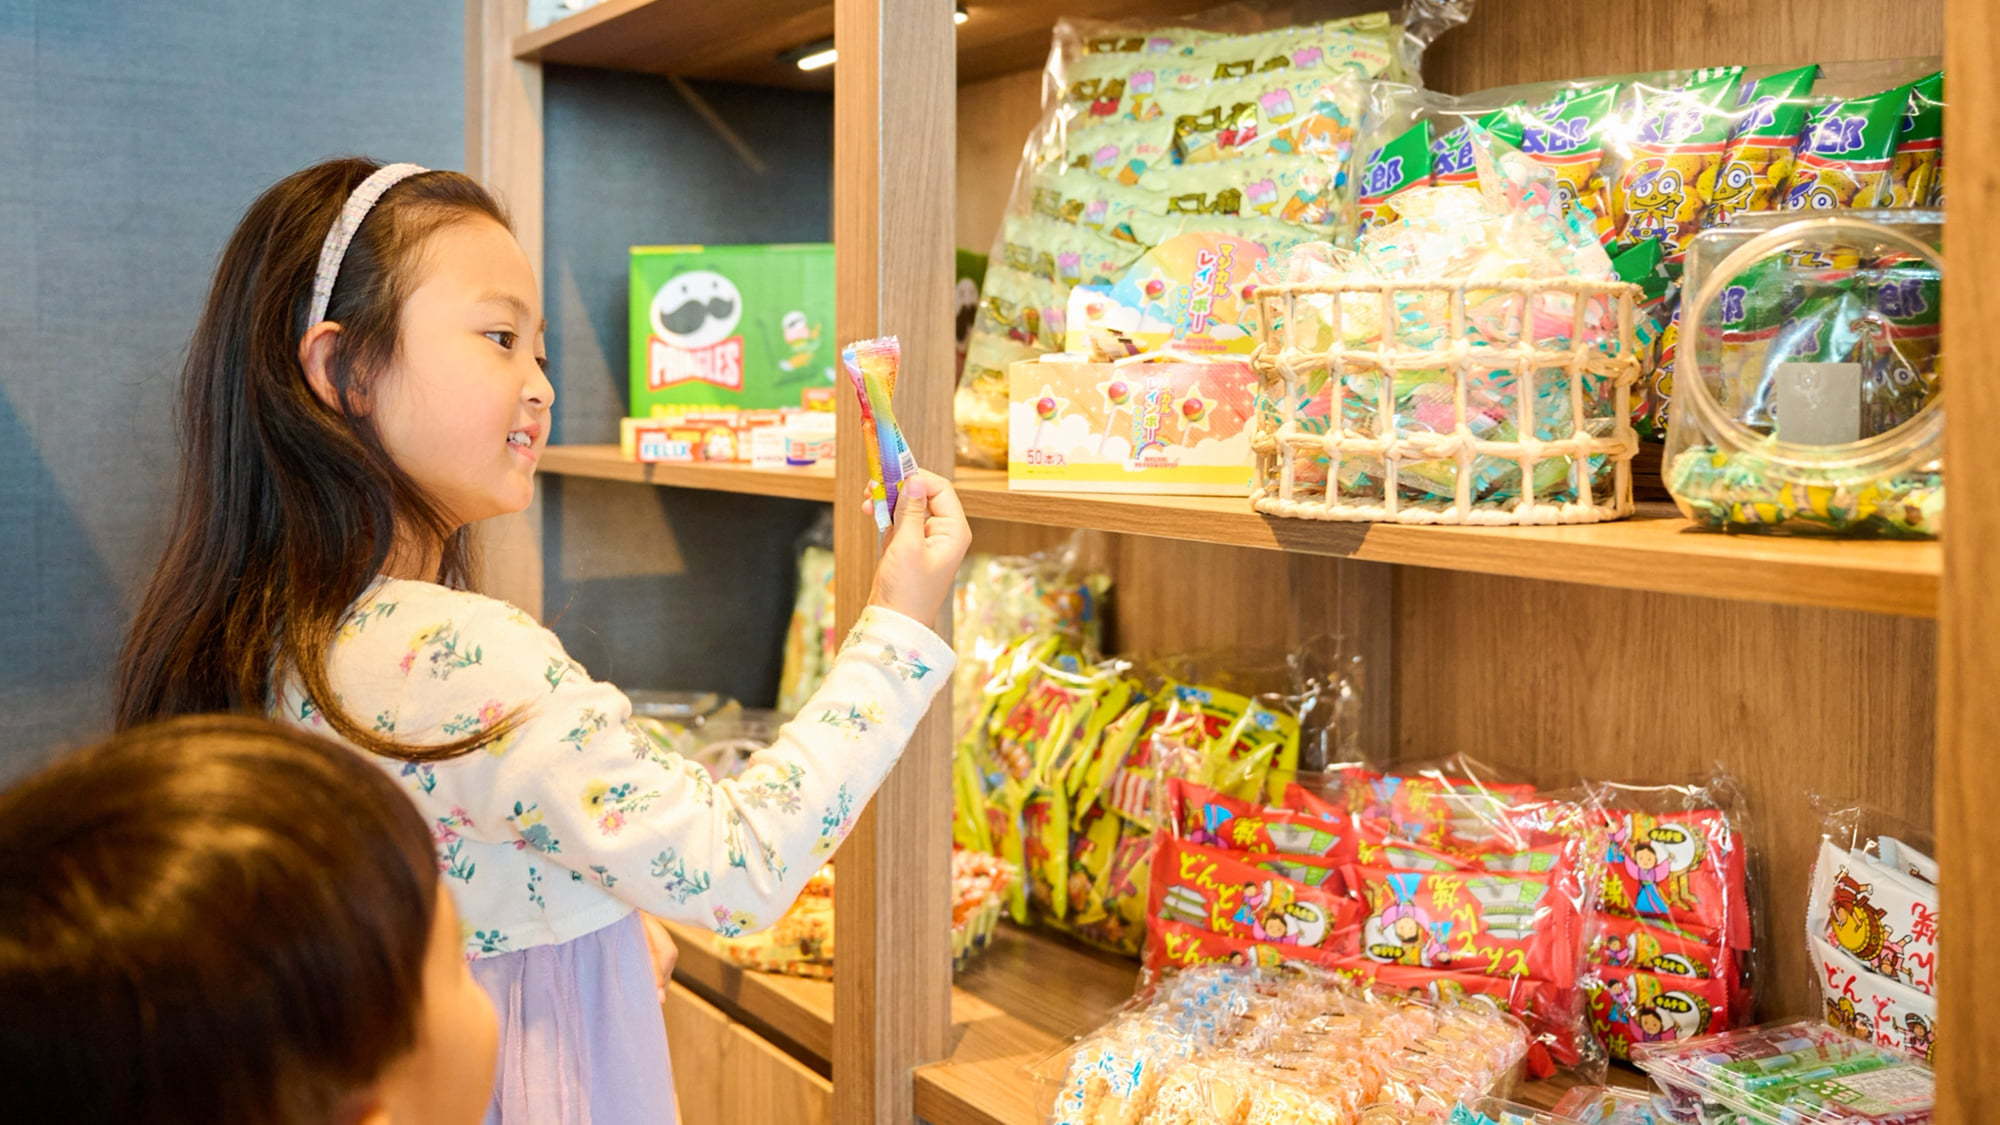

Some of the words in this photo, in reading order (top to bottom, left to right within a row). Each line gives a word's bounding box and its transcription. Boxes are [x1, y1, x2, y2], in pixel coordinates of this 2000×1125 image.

[1026, 449, 1068, 466] 50本入
[1180, 851, 1246, 938] どんどん
